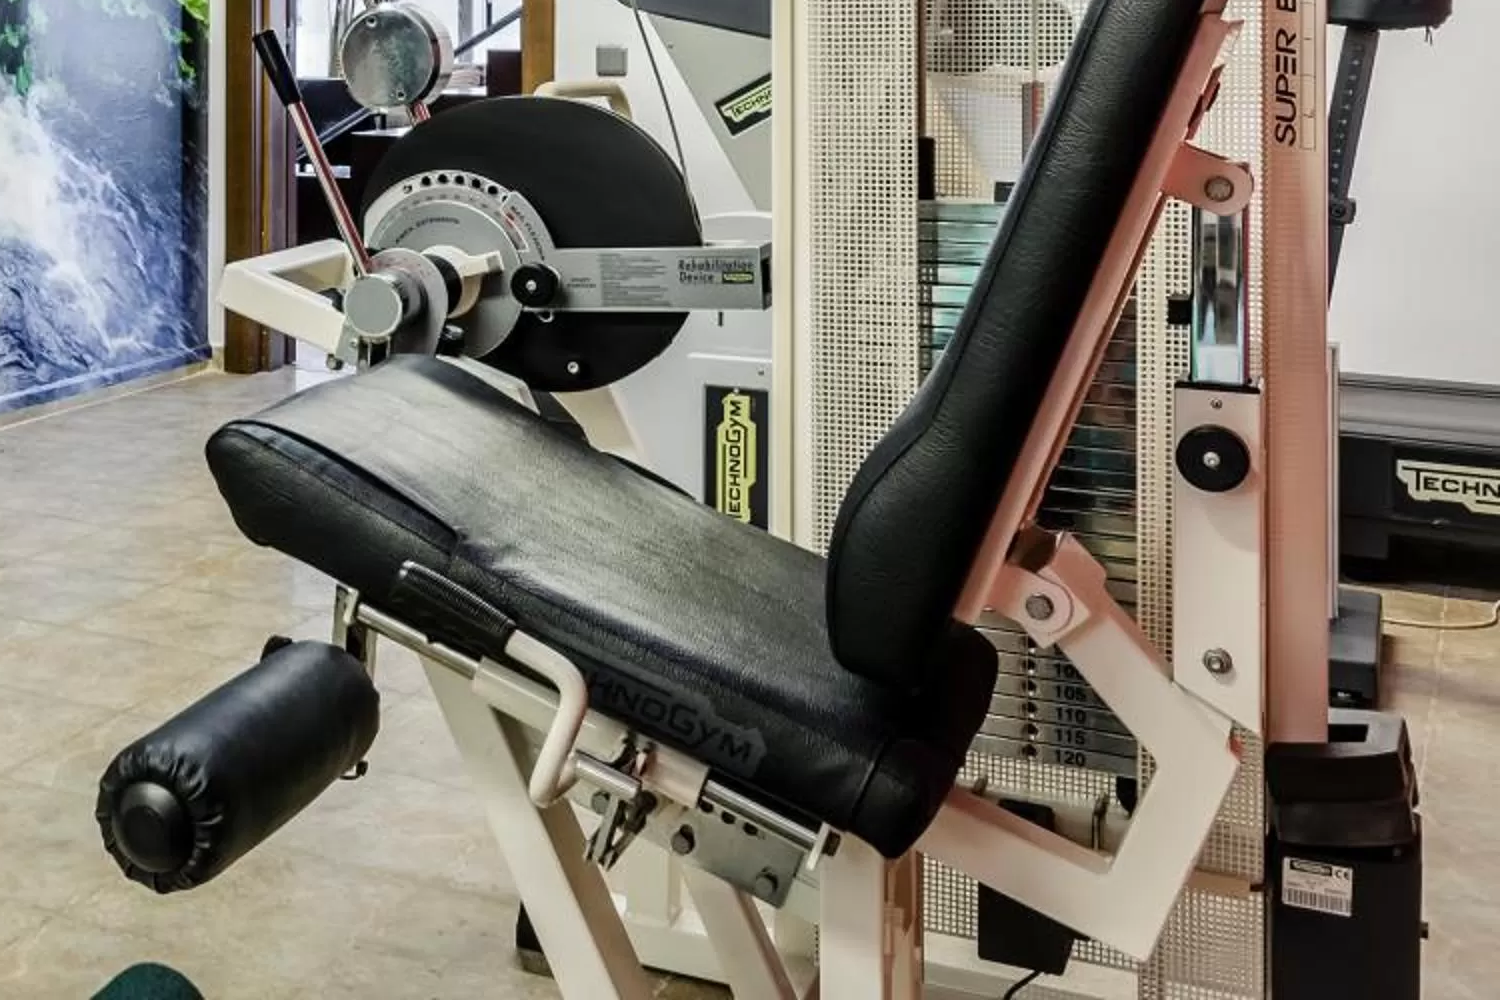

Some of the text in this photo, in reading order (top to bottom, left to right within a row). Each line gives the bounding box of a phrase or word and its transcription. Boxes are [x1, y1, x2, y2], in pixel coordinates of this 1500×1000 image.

[1275, 27, 1297, 147] SUPER
[678, 271, 714, 283] Device
[1055, 663, 1081, 678] 10
[1055, 685, 1087, 701] 105
[1056, 706, 1087, 724] 110
[1056, 728, 1086, 745] 115
[1056, 749, 1086, 767] 120
